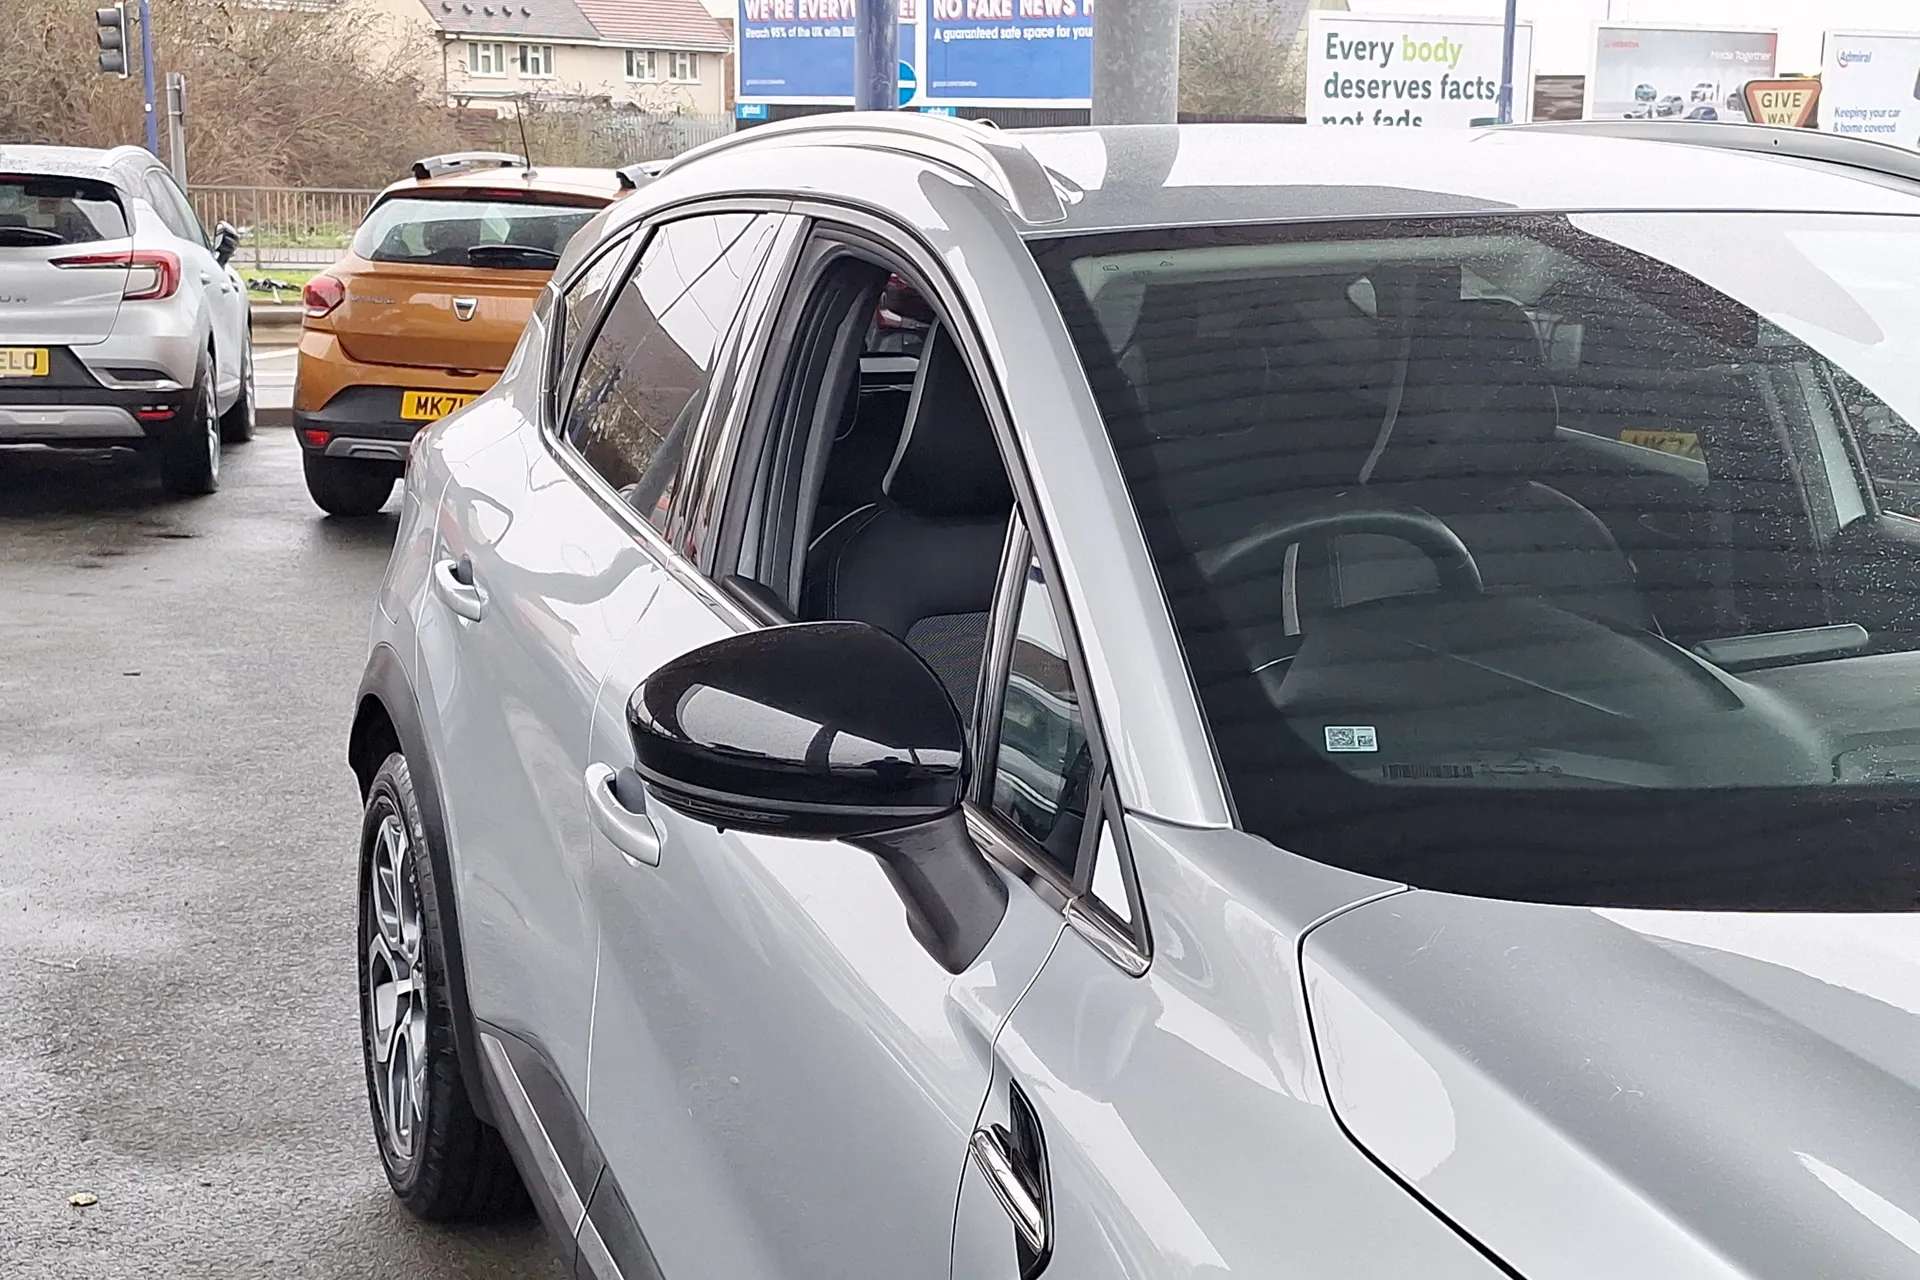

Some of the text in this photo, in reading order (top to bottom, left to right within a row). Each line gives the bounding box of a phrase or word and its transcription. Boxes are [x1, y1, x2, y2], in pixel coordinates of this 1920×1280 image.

[933, 0, 963, 19] NO
[967, 0, 1011, 19] FAKE
[1019, 0, 1076, 17] NEWS
[934, 28, 941, 40] A
[944, 27, 999, 42] guaranteed
[1000, 26, 1022, 39] safe
[1023, 27, 1055, 41] space
[1056, 25, 1072, 38] for
[1326, 33, 1463, 69] Every body
[1324, 71, 1500, 104] deserves facts,
[1761, 92, 1802, 108] GIVE
[1767, 112, 1793, 124] WAY
[1834, 107, 1902, 121] Keeping your car
[1840, 122, 1863, 133] home
[1863, 122, 1896, 133] covered
